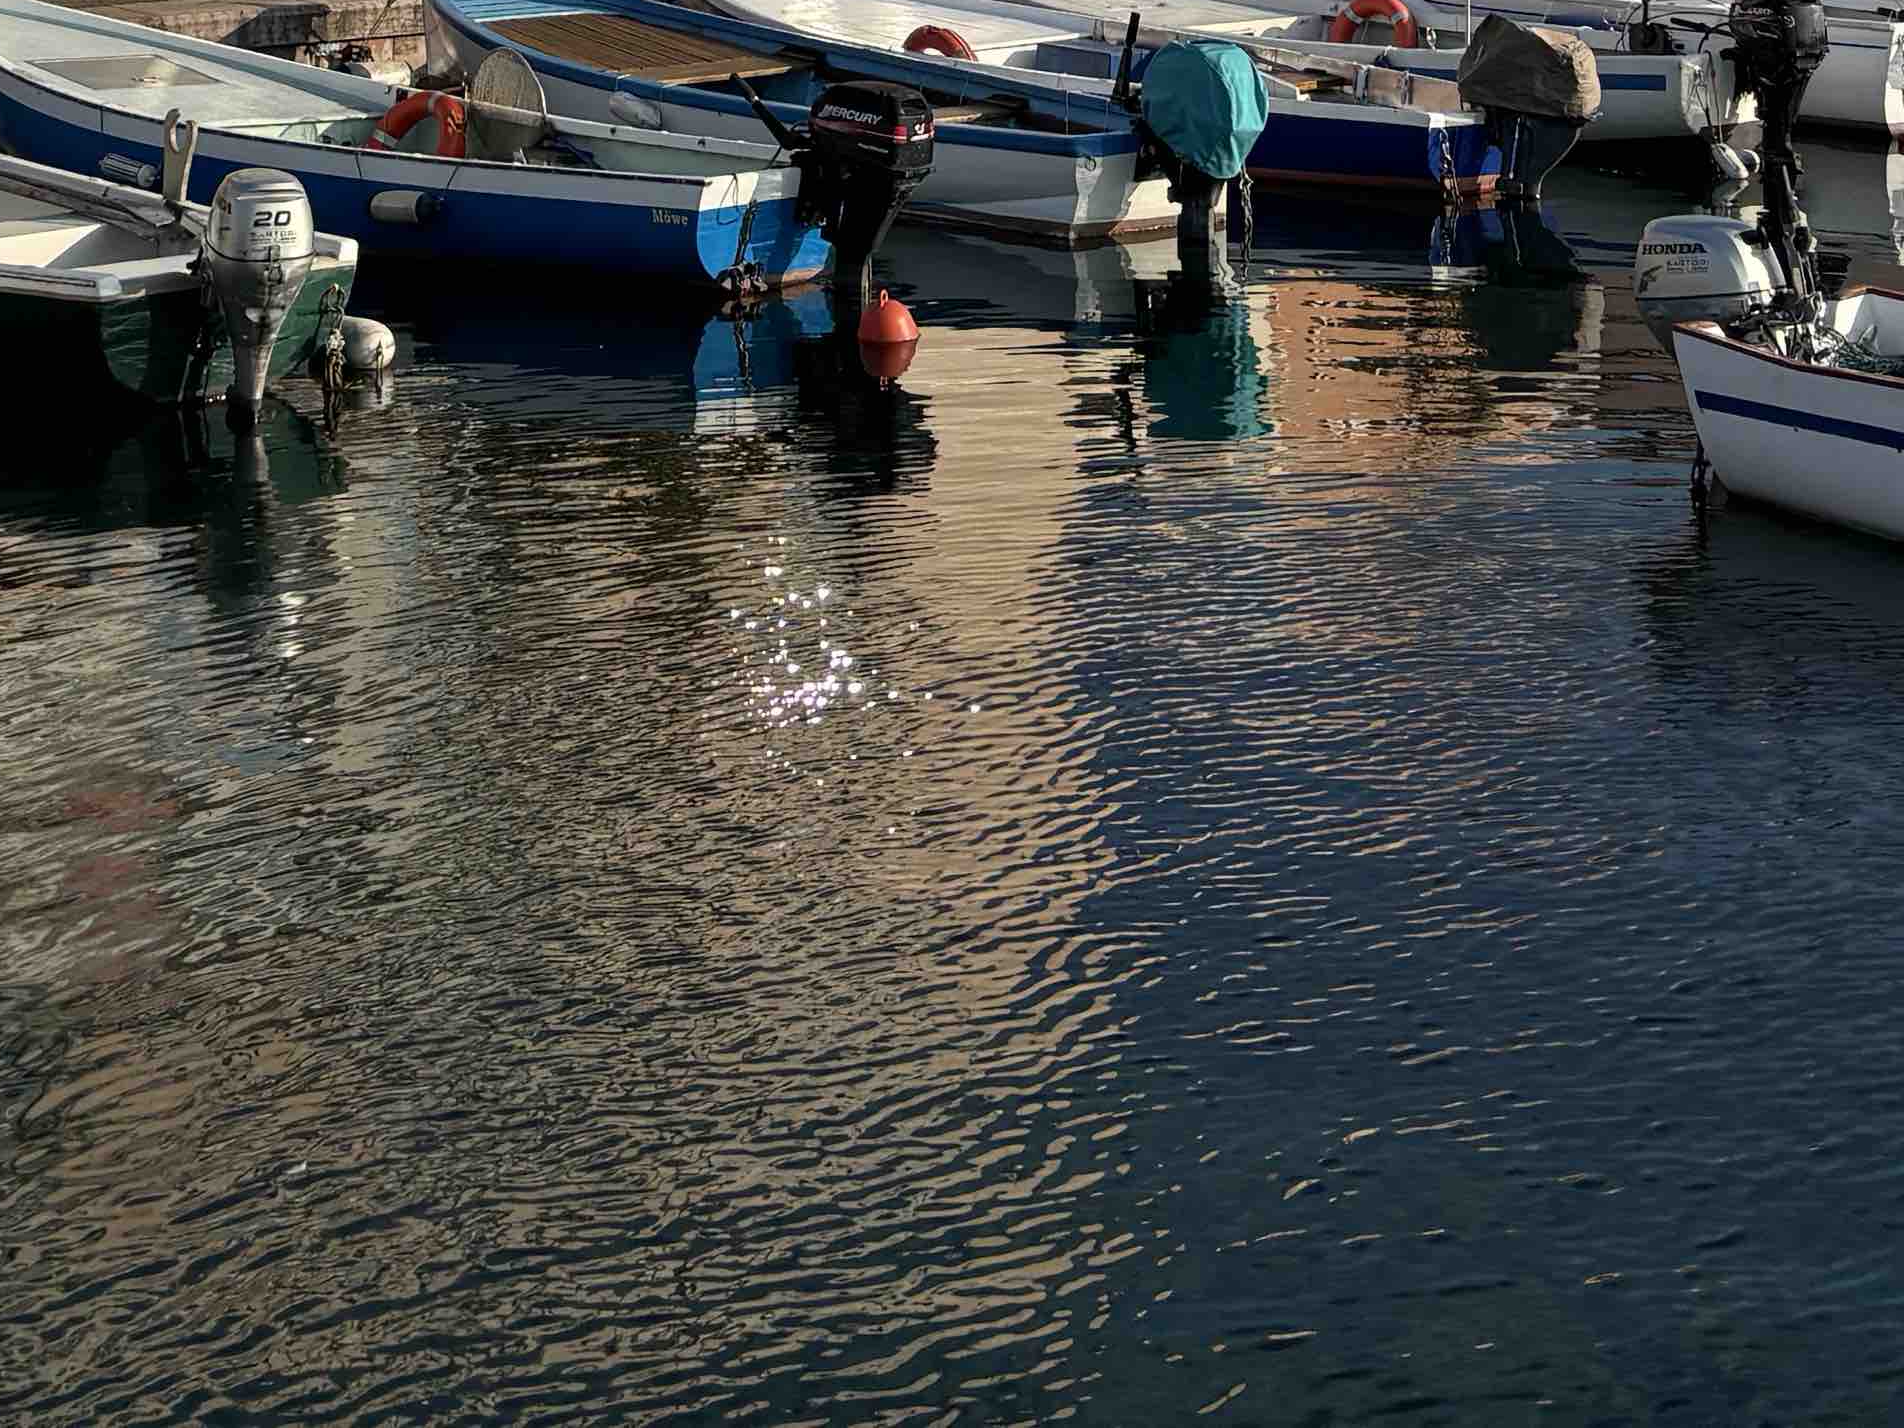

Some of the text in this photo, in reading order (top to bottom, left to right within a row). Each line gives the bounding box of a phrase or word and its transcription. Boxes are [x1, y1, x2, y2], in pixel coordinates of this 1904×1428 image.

[818, 104, 883, 125] MERCURY
[253, 210, 291, 227] 20
[651, 208, 688, 225] Möwe
[1642, 243, 1707, 255] HONDA
